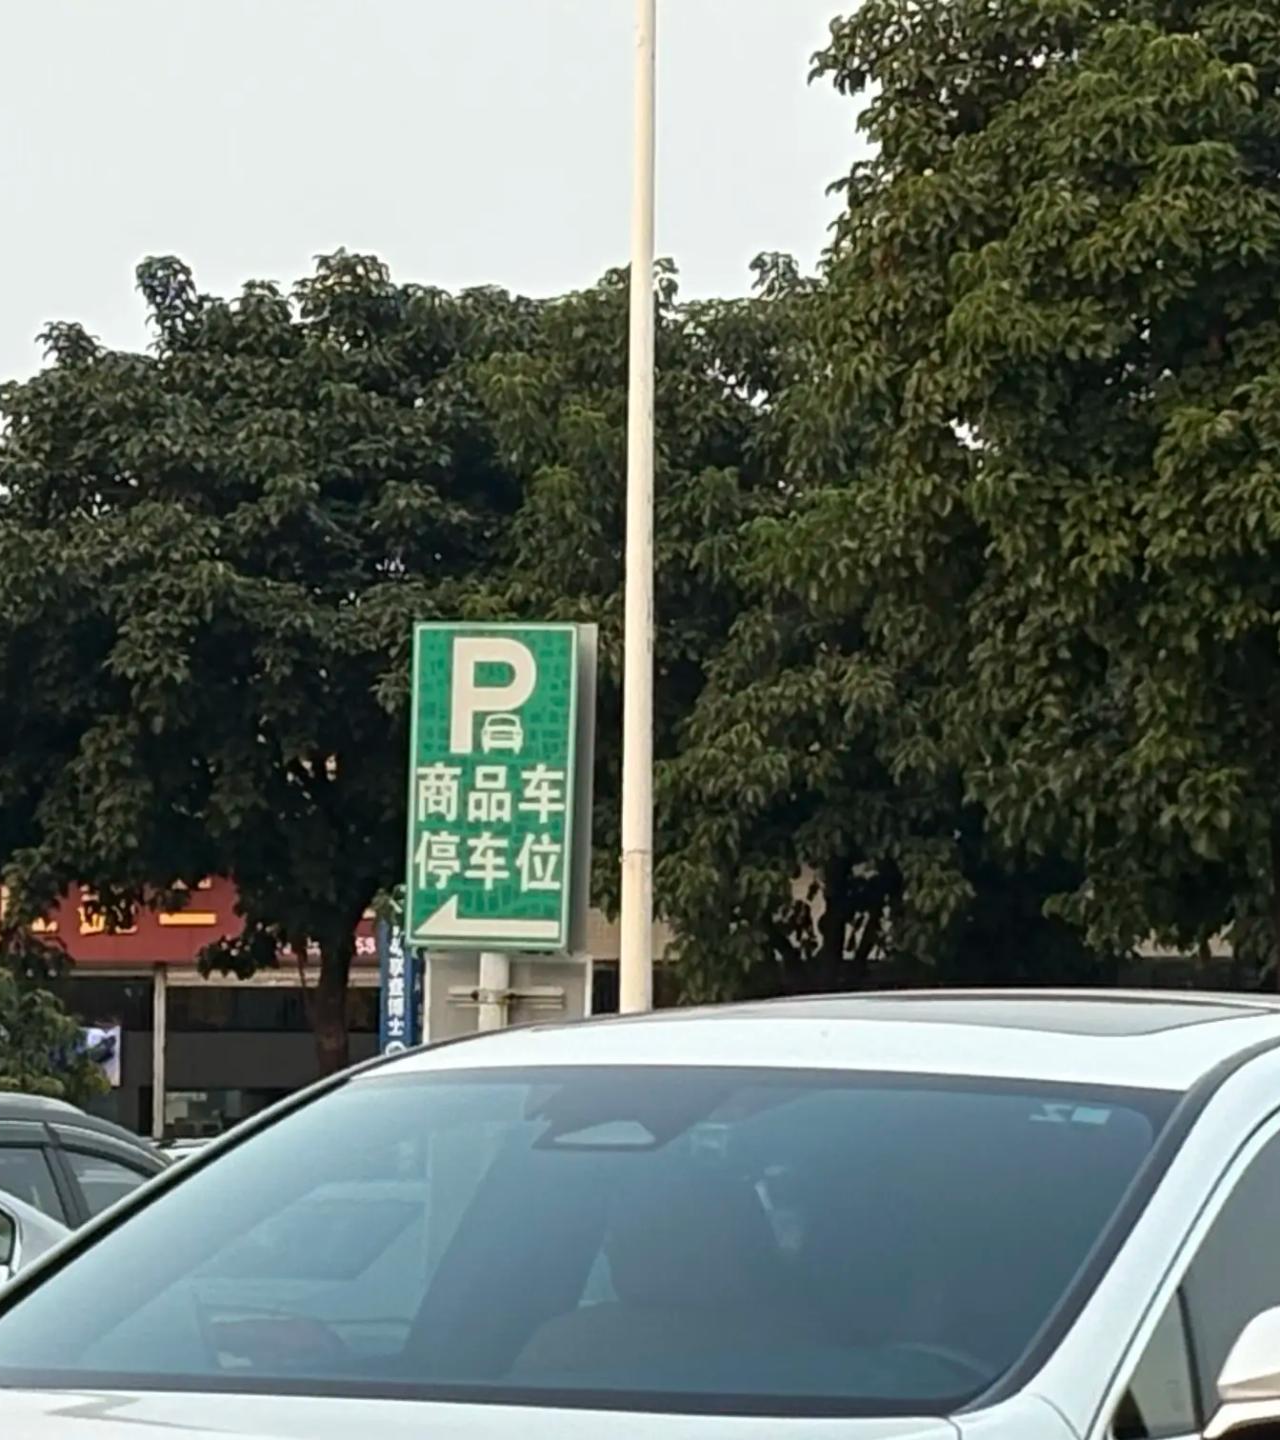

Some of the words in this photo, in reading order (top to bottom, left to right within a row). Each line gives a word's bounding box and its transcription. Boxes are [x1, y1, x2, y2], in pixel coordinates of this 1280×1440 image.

[450, 637, 536, 754] P
[416, 763, 565, 823] 商品车
[414, 831, 562, 891] 停车位
